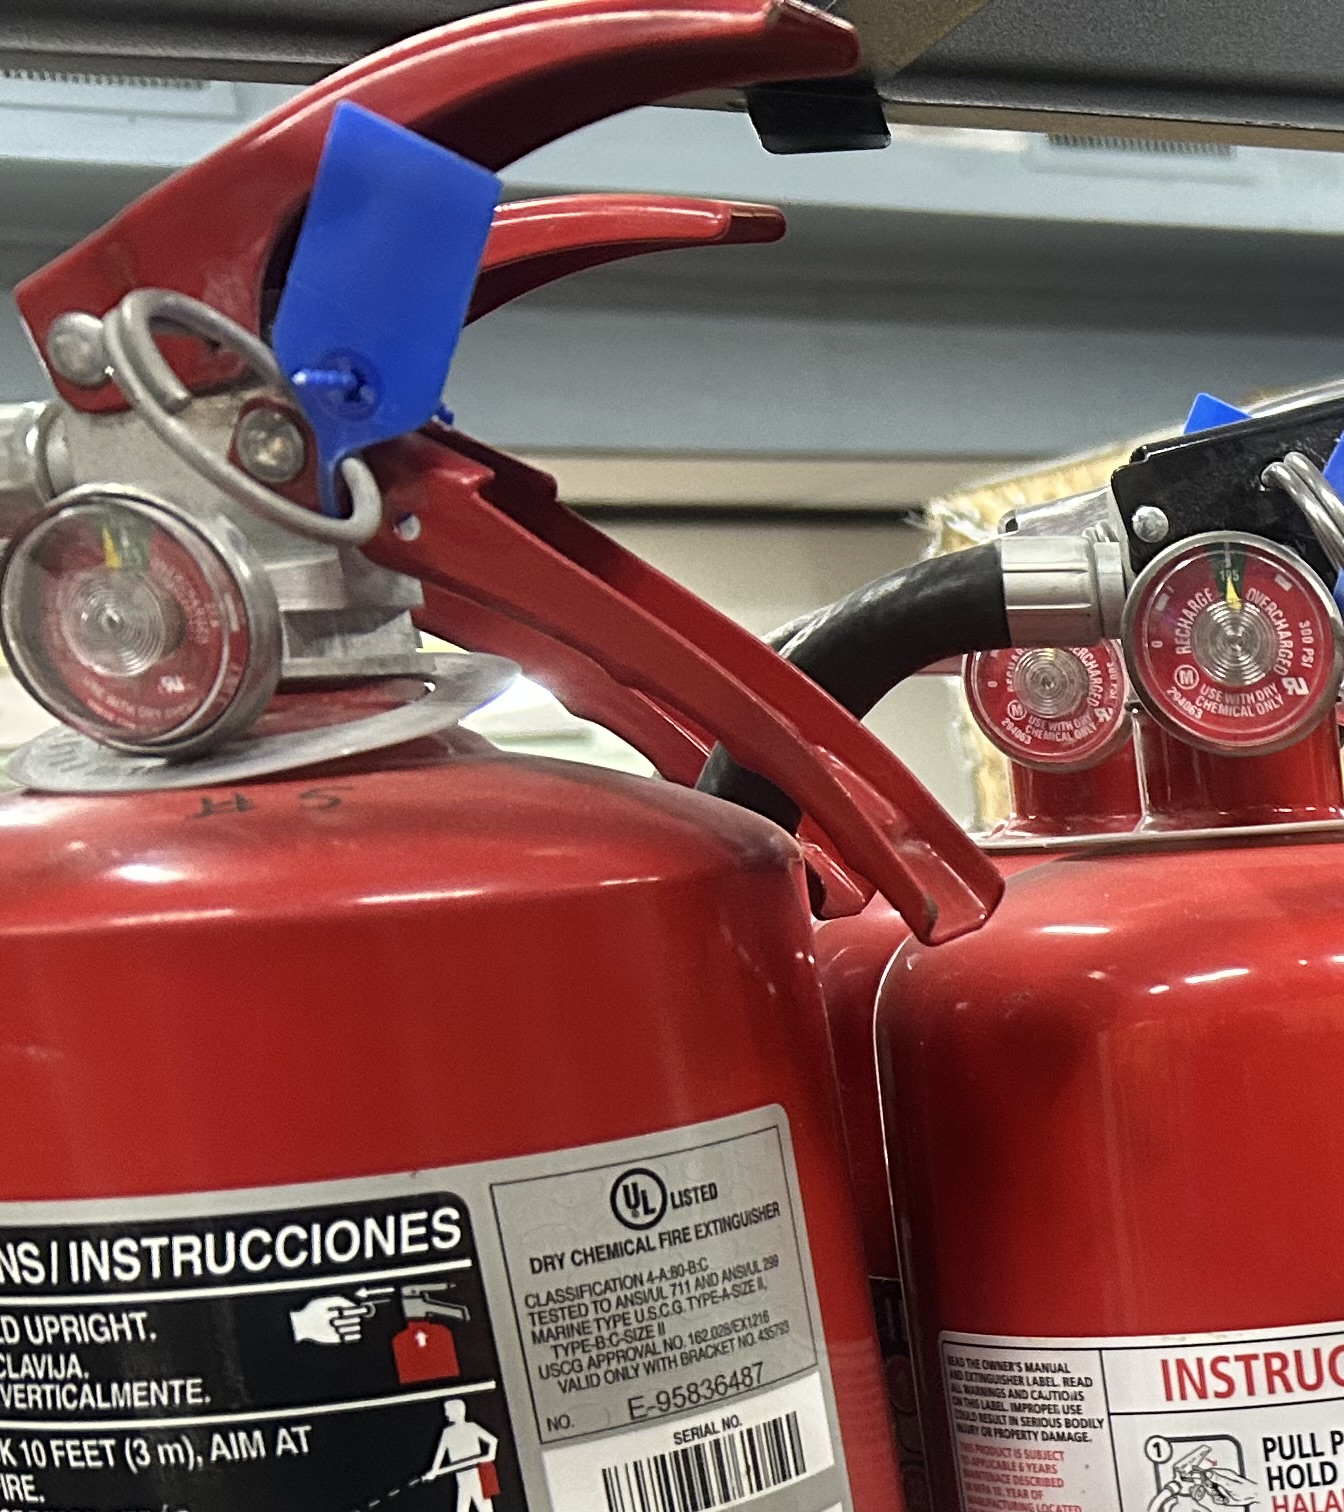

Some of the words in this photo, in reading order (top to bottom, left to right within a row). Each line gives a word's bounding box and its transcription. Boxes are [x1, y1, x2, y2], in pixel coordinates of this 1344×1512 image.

[1175, 586, 1216, 655] RECHARGE
[1246, 587, 1294, 678] OVERCHARGED
[1302, 646, 1314, 670] PSI
[1194, 695, 1251, 718] CHEMICAL
[1254, 695, 1285, 716] ONLY
[670, 1183, 717, 1209] LISTED
[69, 1207, 462, 1282] INSTRUCCIONES
[529, 1253, 565, 1274] DRY
[571, 1235, 656, 1266] CHEMICAL
[659, 1225, 692, 1249] FIRE
[696, 1202, 780, 1241] EXTINGUISHER
[525, 1273, 644, 1309] CLASSIFICATION
[28, 1312, 156, 1345] UPRIGHT.
[546, 1414, 575, 1431] NO.
[627, 1363, 765, 1420] E-95836487
[673, 1422, 719, 1445] SERIAL
[722, 1415, 742, 1433] NO.
[20, 1439, 49, 1466] 10
[53, 1437, 115, 1469] FEET
[124, 1437, 149, 1473] (3
[211, 1431, 265, 1462] AIM
[276, 1427, 311, 1455] AT
[1262, 1435, 1324, 1461] PULL
[1266, 1463, 1338, 1492] HOLD
